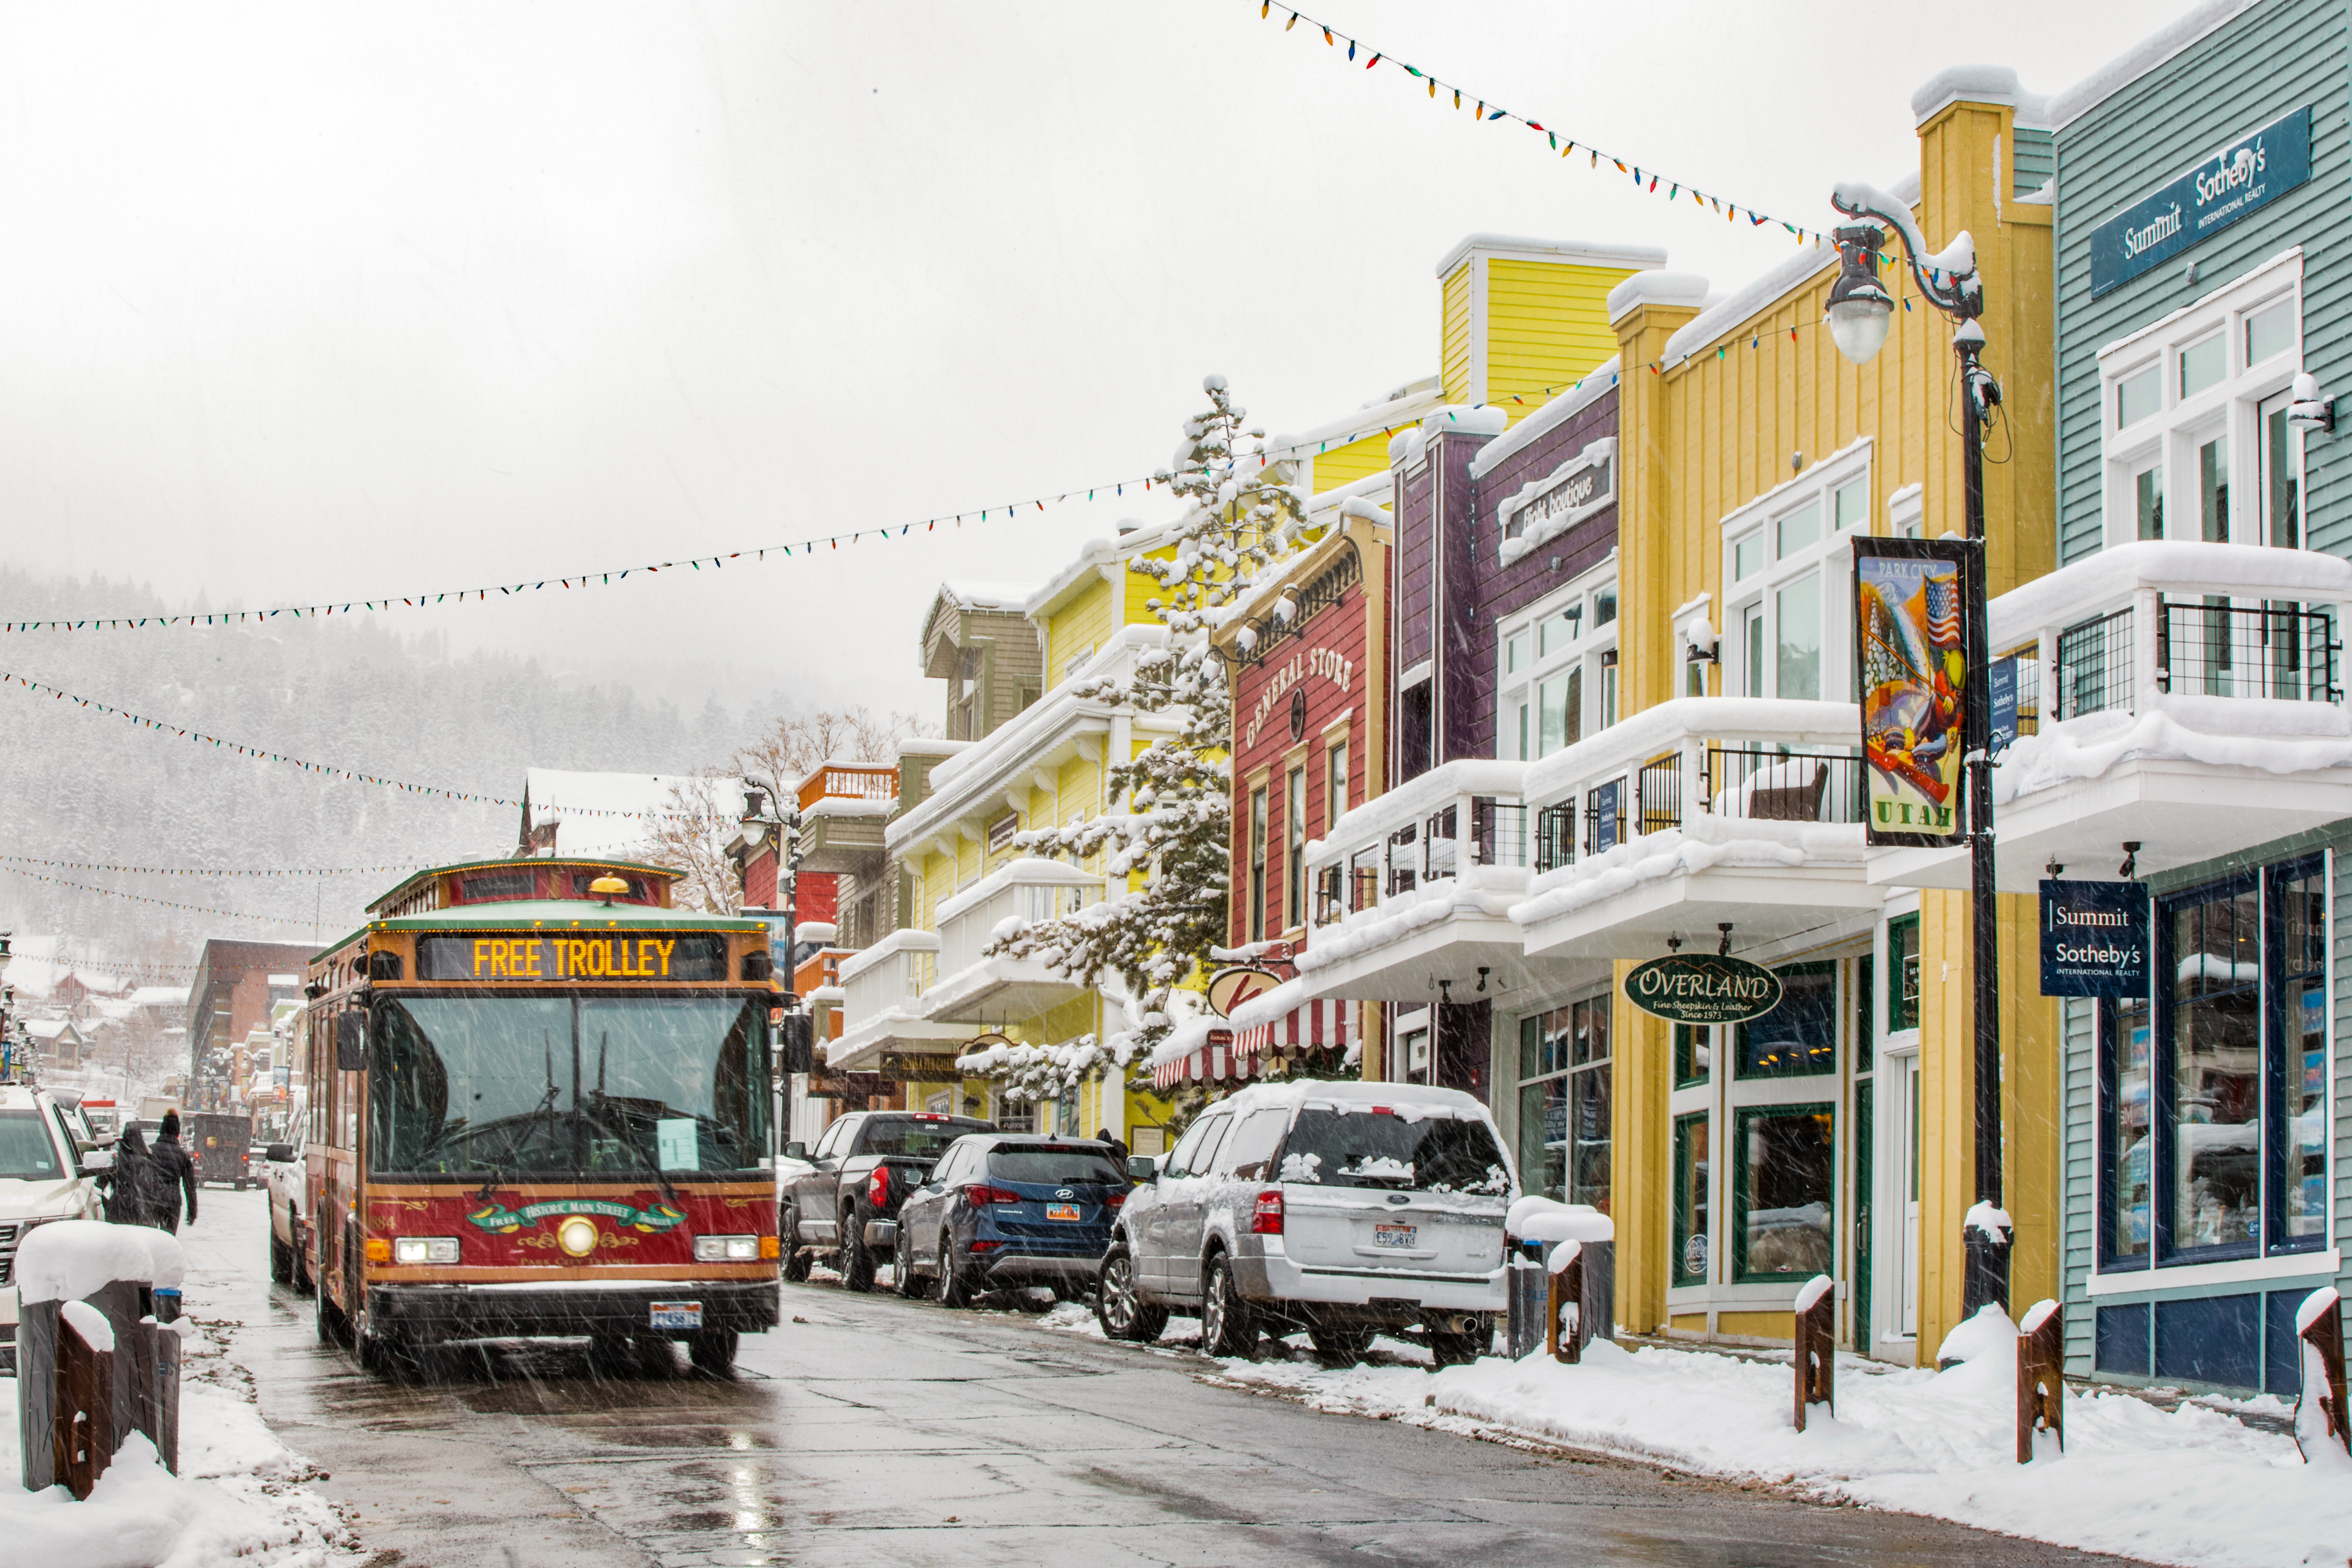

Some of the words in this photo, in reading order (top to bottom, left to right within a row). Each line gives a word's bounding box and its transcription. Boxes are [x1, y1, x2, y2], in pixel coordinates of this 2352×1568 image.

[2196, 136, 2266, 207] Sotheby's
[2198, 197, 2244, 230] INTERNATIONAL
[2244, 183, 2266, 204] REALTY
[2125, 201, 2182, 260] Summit
[1549, 476, 1593, 518] boutique
[1879, 562, 1909, 579] PARK
[1906, 563, 1937, 579] CITY
[1993, 674, 2009, 688] Summit
[1247, 653, 1304, 749] GENERAL
[1310, 647, 1353, 693] STORE
[1993, 693, 2014, 708] Sotheby's
[1875, 801, 1952, 827] UTAH
[2056, 906, 2129, 926] Summit
[474, 939, 542, 976] FREE
[552, 939, 675, 976] TROLLEY
[2056, 943, 2141, 969] Sotheby's
[1639, 967, 1768, 999] OVERLAND
[1653, 1000, 1672, 1009] Fine
[1672, 1000, 1710, 1011] Sheepskin
[1721, 1002, 1752, 1011] Leather
[489, 1214, 518, 1227] FREE
[525, 1202, 566, 1219] HISTORIC
[569, 1201, 594, 1213] MAIN
[596, 1202, 629, 1217] STREET
